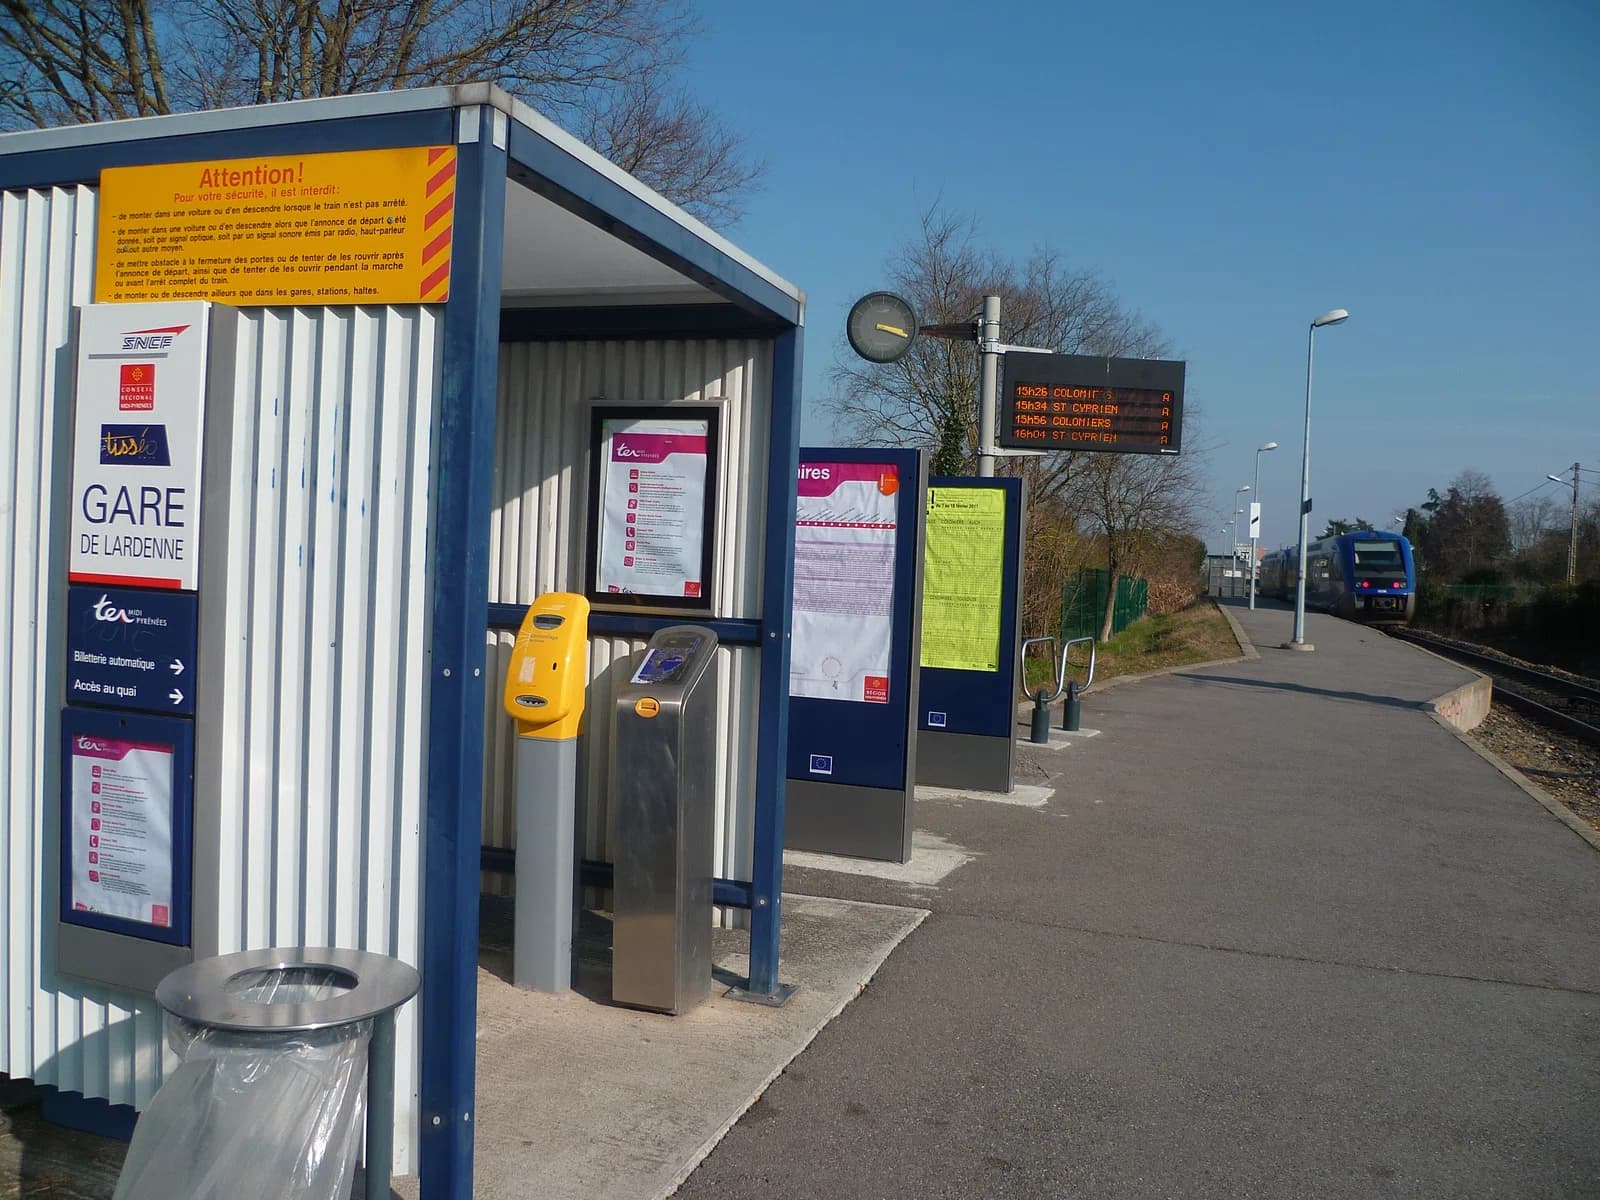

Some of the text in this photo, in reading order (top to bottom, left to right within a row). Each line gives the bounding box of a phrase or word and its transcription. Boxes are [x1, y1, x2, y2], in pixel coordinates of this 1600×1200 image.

[174, 193, 194, 202] Pour
[198, 192, 221, 201] votre
[271, 188, 276, 198] il
[281, 188, 296, 197] est
[226, 206, 240, 214] d'en
[243, 205, 281, 213] descendre
[284, 204, 311, 212] lorsque
[324, 201, 340, 209] train
[360, 217, 384, 226] départ
[170, 235, 187, 243] signal
[257, 231, 276, 240] signal
[361, 227, 405, 235] haut-parleur
[251, 255, 274, 263] portes
[290, 254, 298, 262] de
[382, 251, 404, 260] après
[324, 263, 357, 272] pendant
[169, 277, 196, 286] complet
[211, 288, 236, 297] ailleurs
[122, 335, 173, 350] SNCF
[1017, 386, 1048, 397] 15h26
[1054, 387, 1112, 400] COLOMIS
[1016, 400, 1169, 416] 15h34 ST CYPRIEN A
[1016, 415, 1168, 430] 15h56 COLOMIERS A
[1015, 429, 1168, 444] 16h04 ST CYPRIEN A
[616, 443, 640, 456] ter
[797, 464, 830, 480] ires
[83, 484, 185, 527] GARE
[81, 534, 184, 561] DE LARDENNE
[92, 594, 135, 623] ter
[74, 651, 155, 671] Billetterie automatique
[74, 679, 136, 697] Accès au quai
[77, 736, 101, 751] ter
